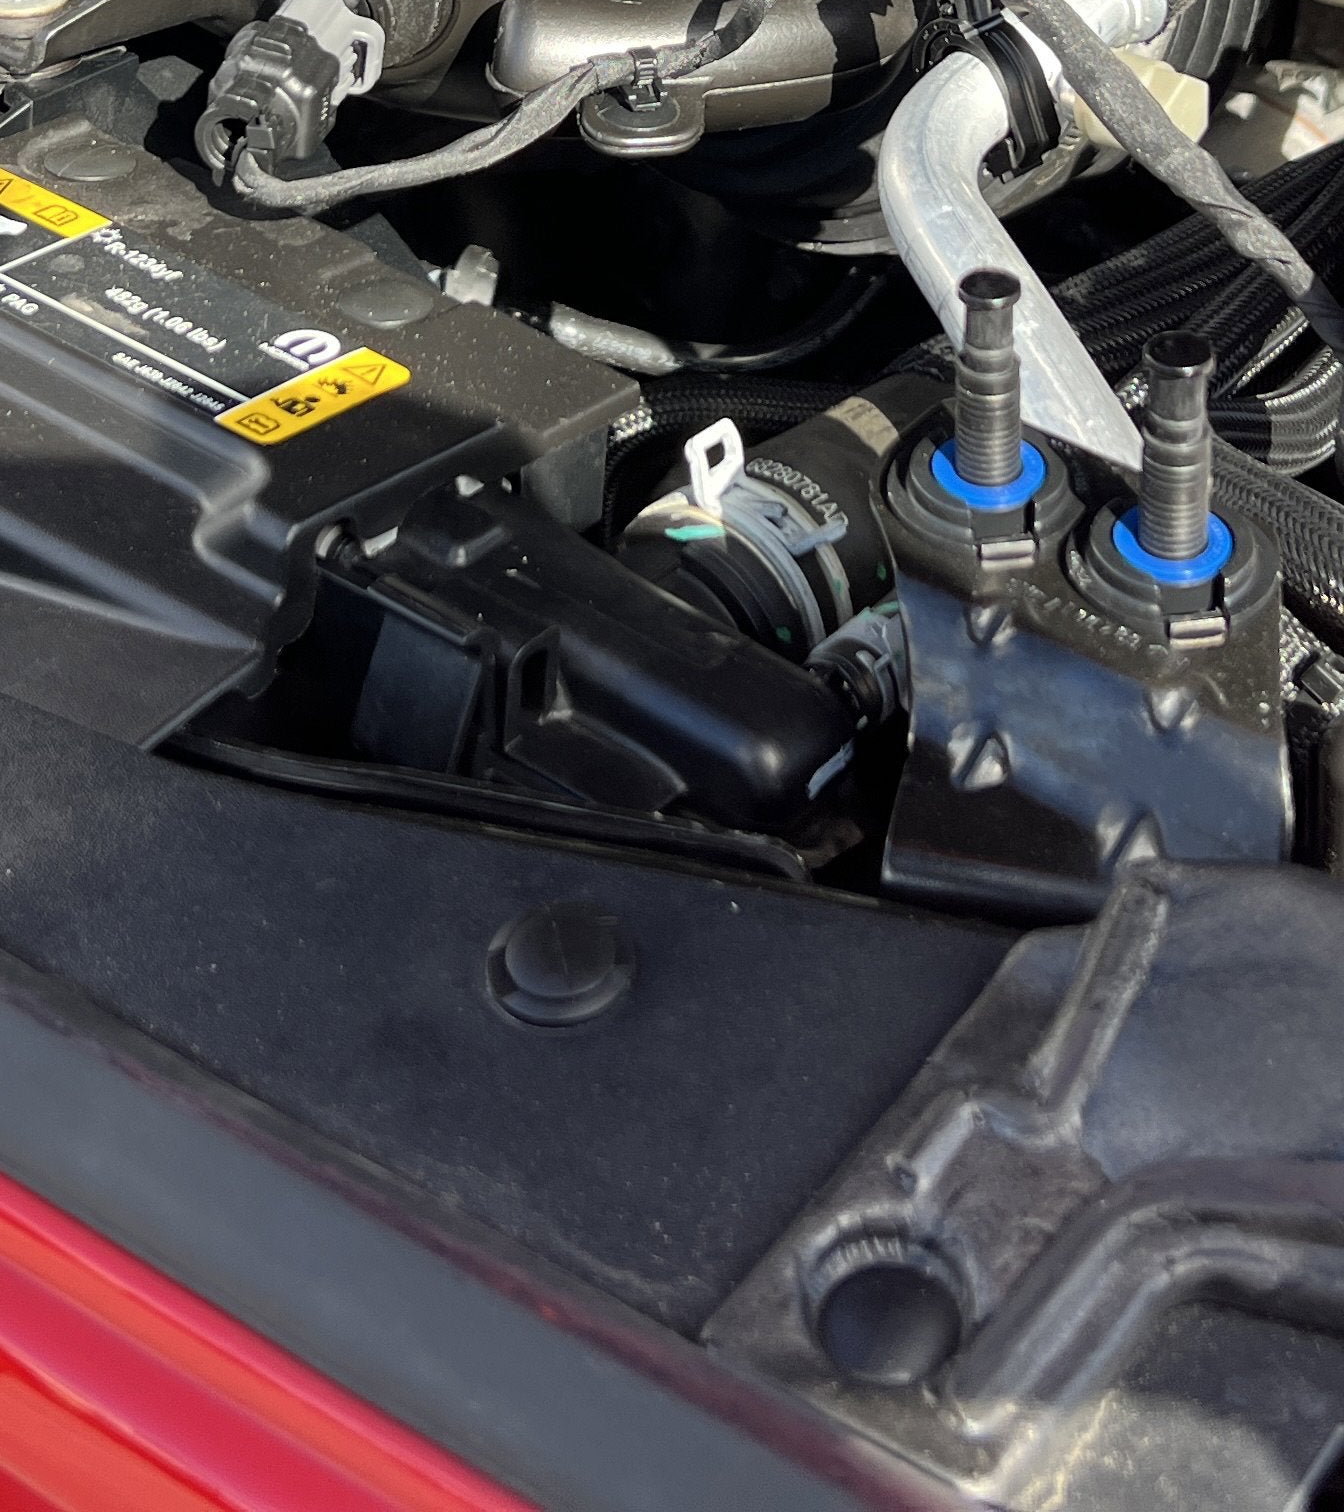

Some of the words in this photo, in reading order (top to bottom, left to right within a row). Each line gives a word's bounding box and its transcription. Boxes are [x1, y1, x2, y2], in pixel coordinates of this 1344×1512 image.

[104, 241, 183, 282] R-1234yf
[1, 293, 39, 316] PAG
[105, 287, 149, 315] 482g
[142, 307, 193, 335] (1.06
[186, 327, 227, 354] lbs)
